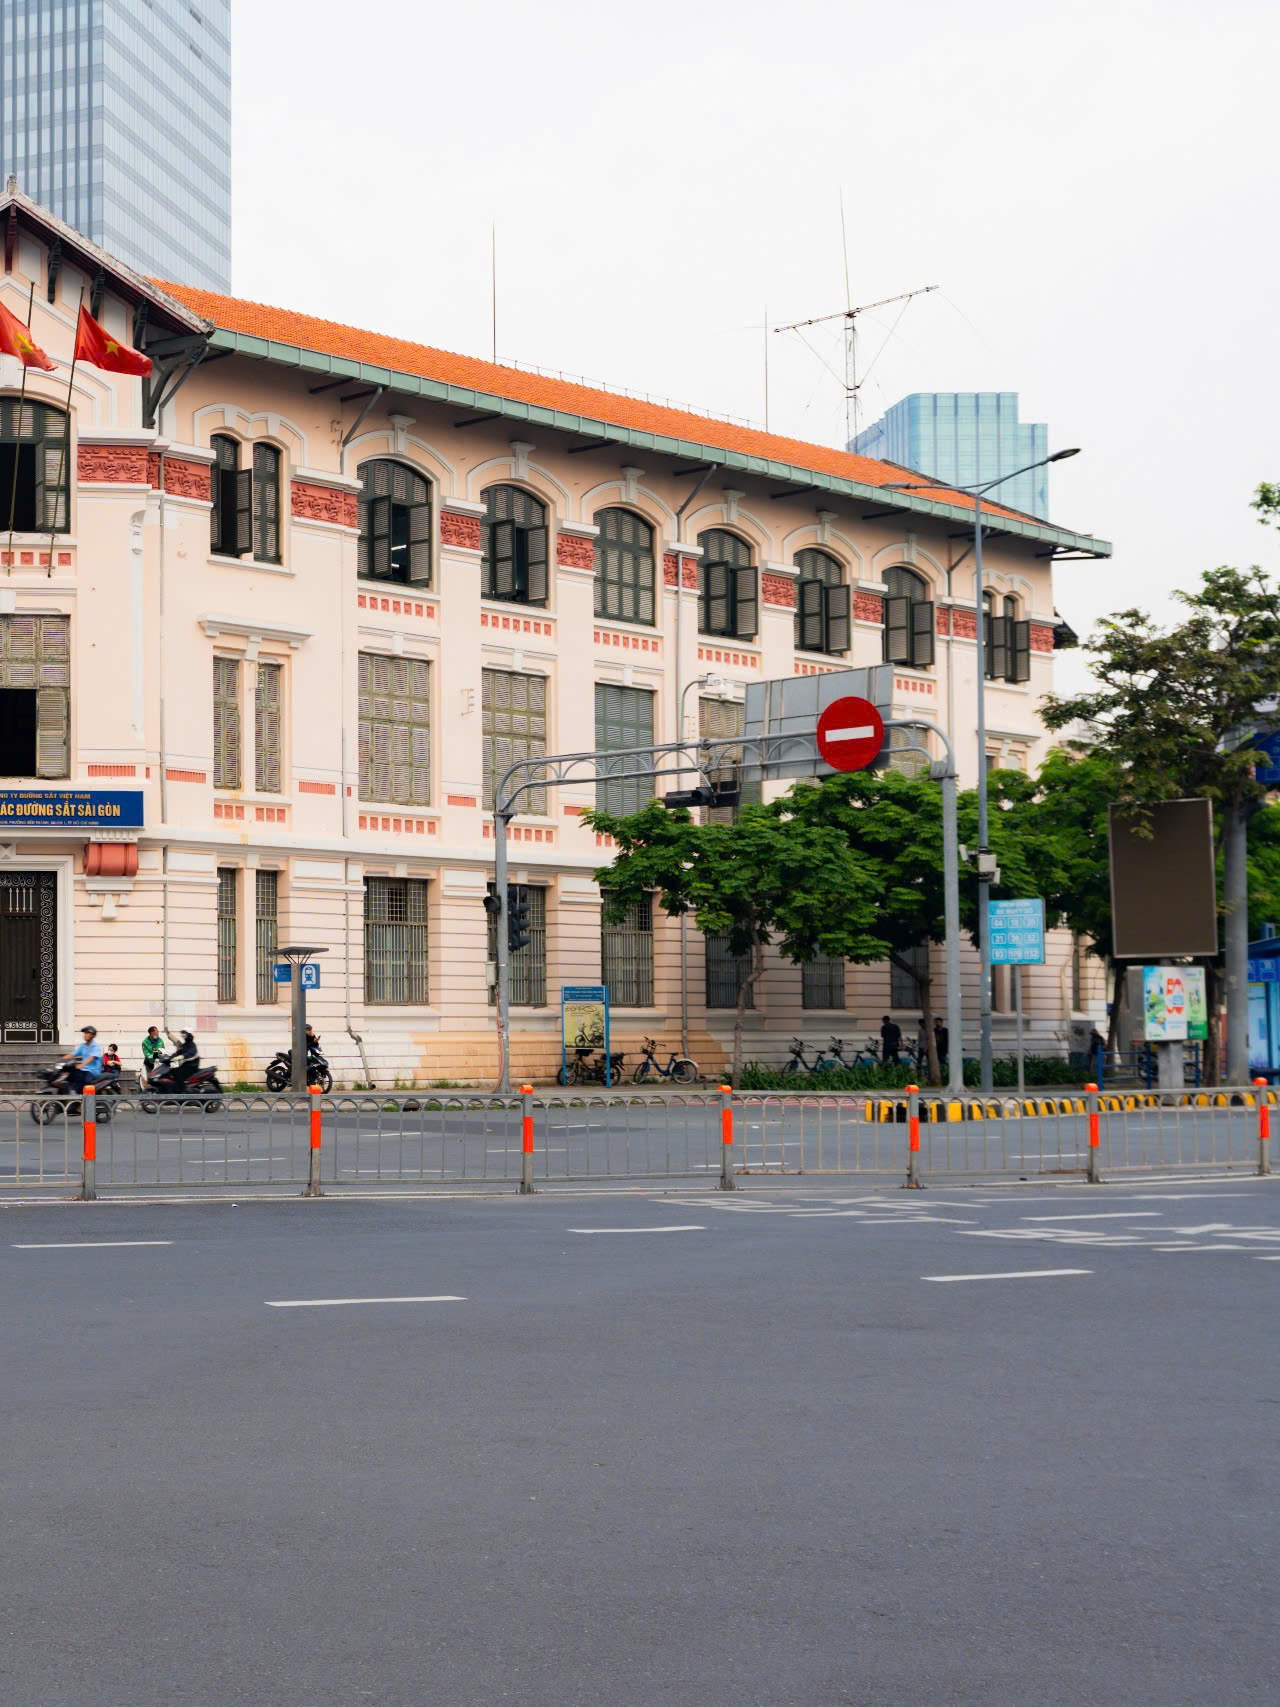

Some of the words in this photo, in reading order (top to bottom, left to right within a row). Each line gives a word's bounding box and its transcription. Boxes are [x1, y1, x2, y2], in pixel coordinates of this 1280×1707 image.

[16, 801, 54, 816] ĐƯỜNG
[55, 800, 76, 816] SẮT
[77, 802, 96, 816] SÀI
[97, 802, 121, 816] GÒN
